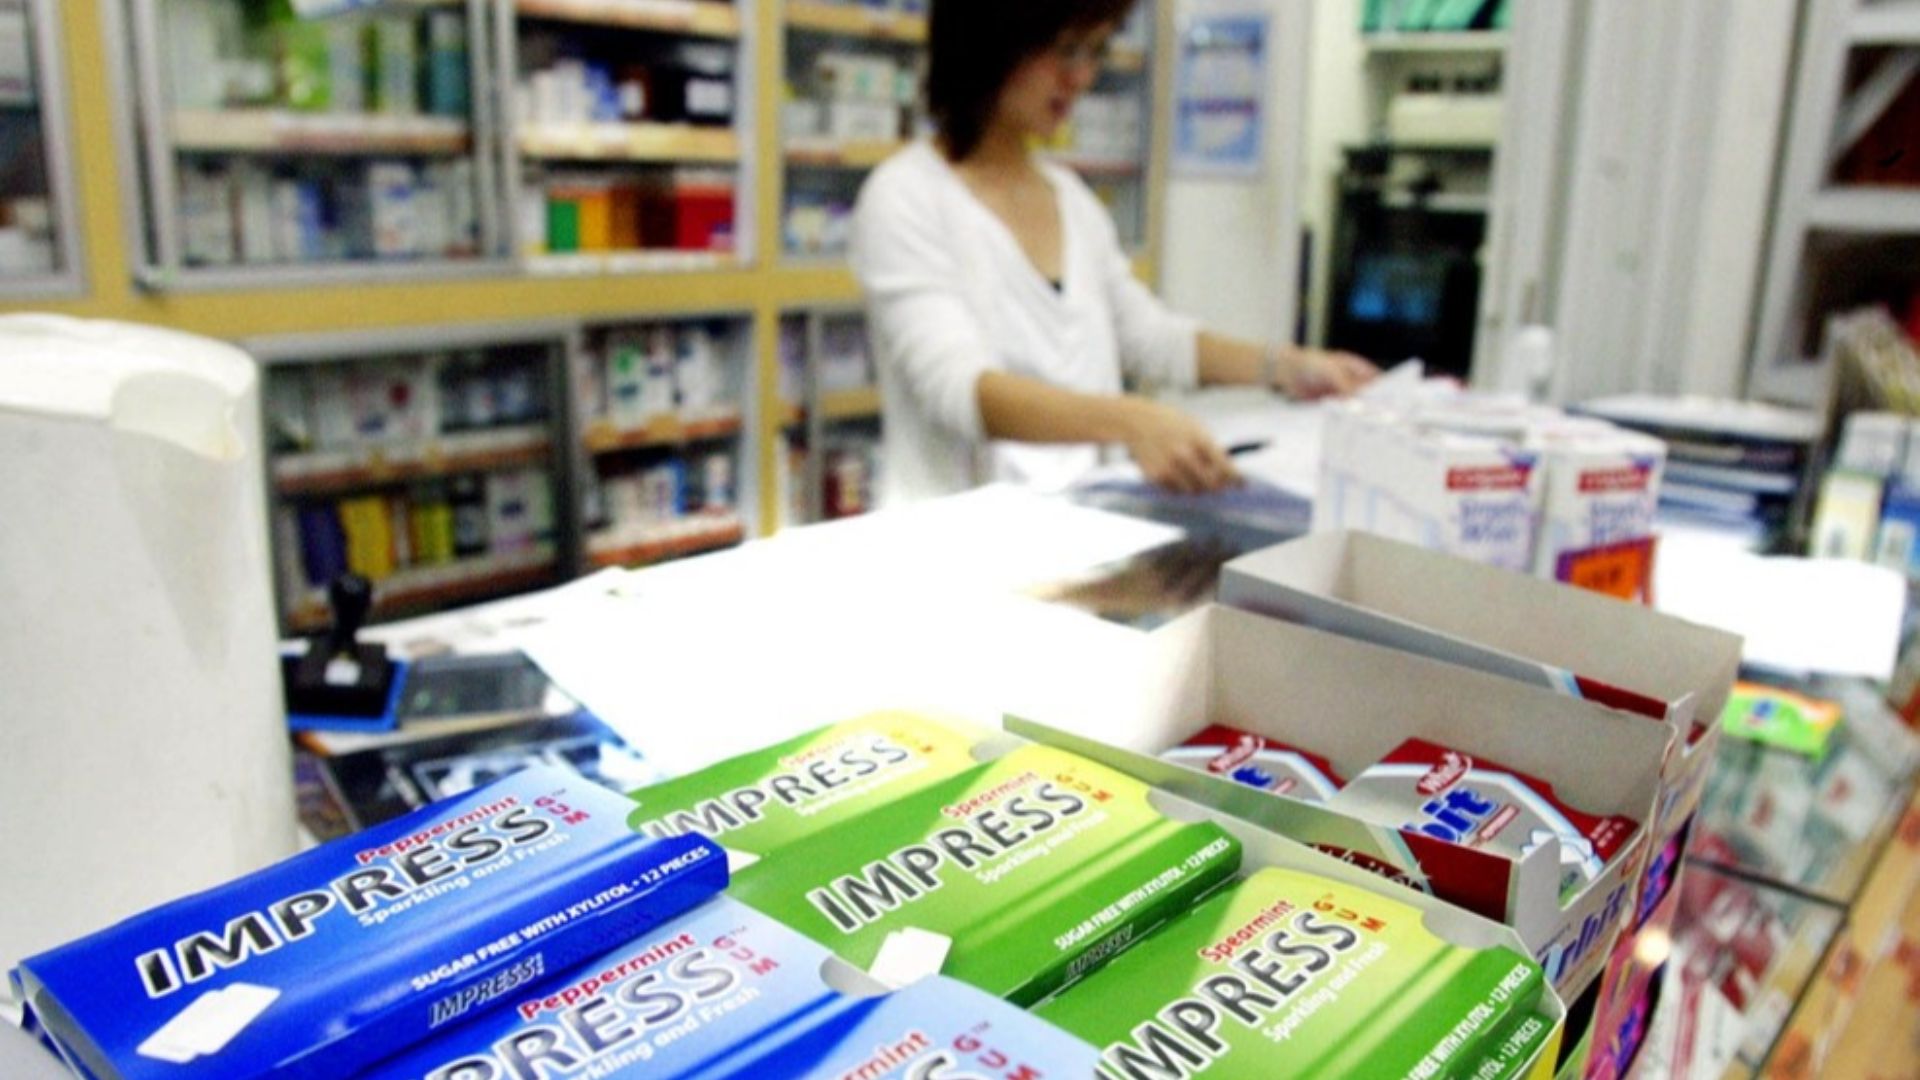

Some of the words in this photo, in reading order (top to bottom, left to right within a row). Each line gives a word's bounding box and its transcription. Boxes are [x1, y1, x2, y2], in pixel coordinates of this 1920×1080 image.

[357, 796, 518, 864] Peppermint
[534, 796, 589, 826] GUM
[641, 738, 911, 838] IMPRESS
[358, 874, 471, 927] Sparkling
[472, 857, 513, 879] and
[514, 832, 570, 862] Fresh
[806, 783, 1086, 933] IMPRESS
[137, 806, 554, 1000] IMPRESS
[411, 953, 477, 991] SUGAR
[477, 931, 521, 961] FREE
[520, 911, 568, 940] WITH
[567, 883, 635, 919] XYLITOL
[639, 868, 660, 886] 12
[660, 846, 711, 876] PIECES
[1054, 917, 1096, 950] SUGAR
[1199, 900, 1295, 963] Spearmint
[1313, 900, 1387, 932] GUM
[518, 933, 696, 1020] Peppermint
[713, 936, 780, 977] GUM
[654, 1019, 697, 1046] and
[953, 1034, 1042, 1080] GUM
